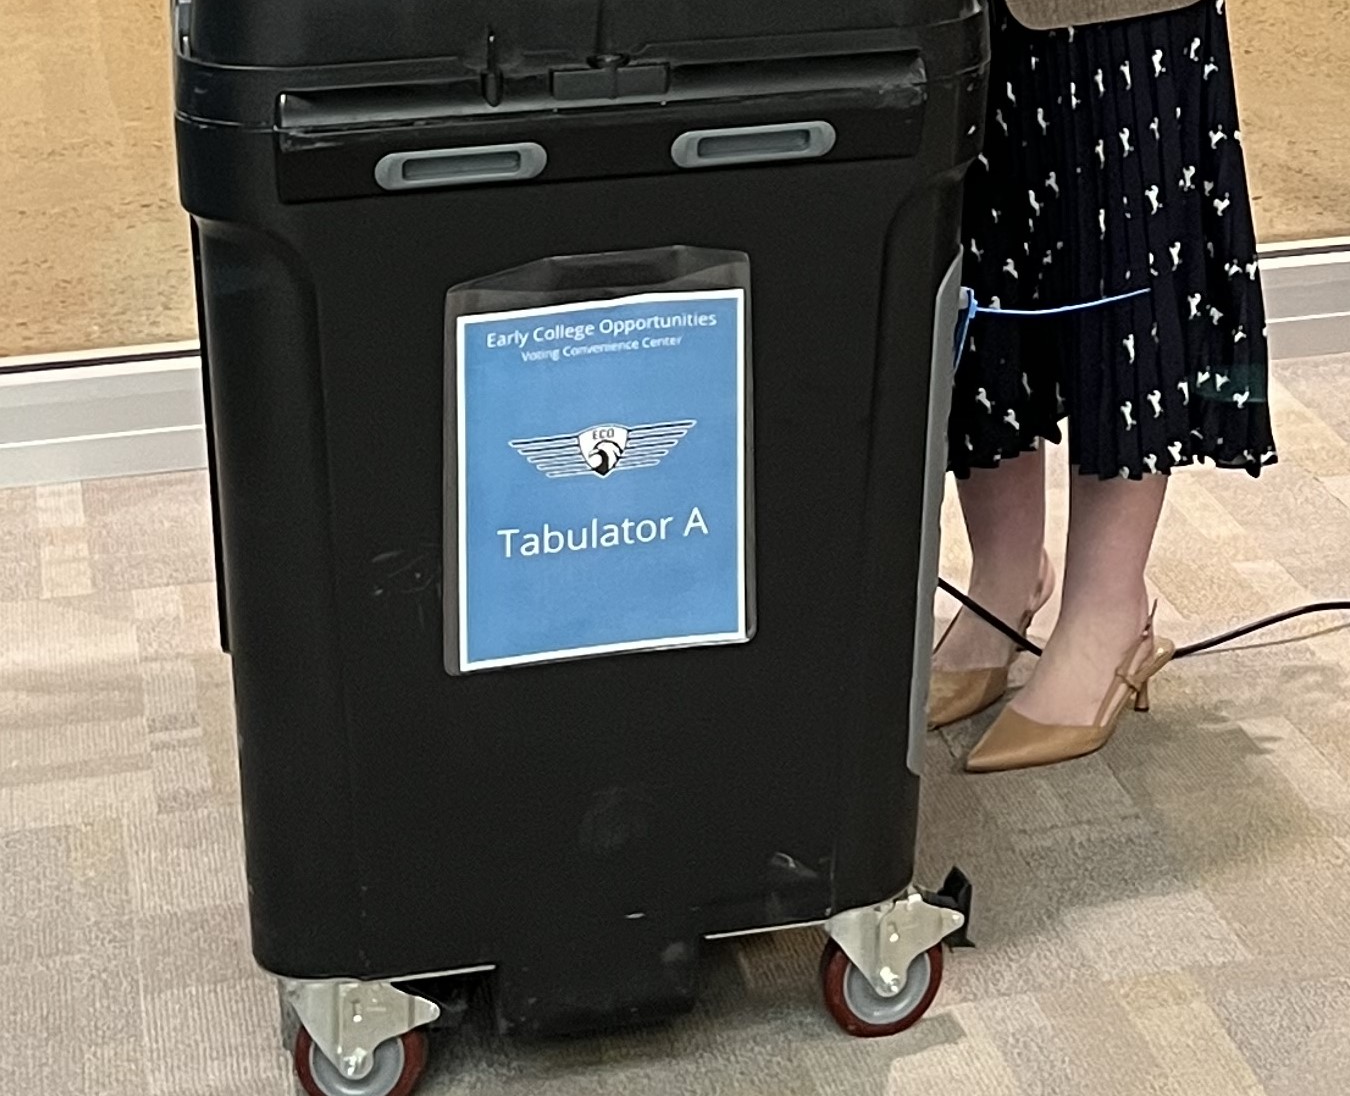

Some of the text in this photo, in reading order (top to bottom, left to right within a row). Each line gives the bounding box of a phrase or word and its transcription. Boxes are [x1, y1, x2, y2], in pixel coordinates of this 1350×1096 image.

[486, 313, 718, 349] Early College Opportunities
[521, 335, 682, 362] Voting Convenience Center
[592, 427, 616, 440] ECO
[496, 506, 709, 558] Tabulator A
